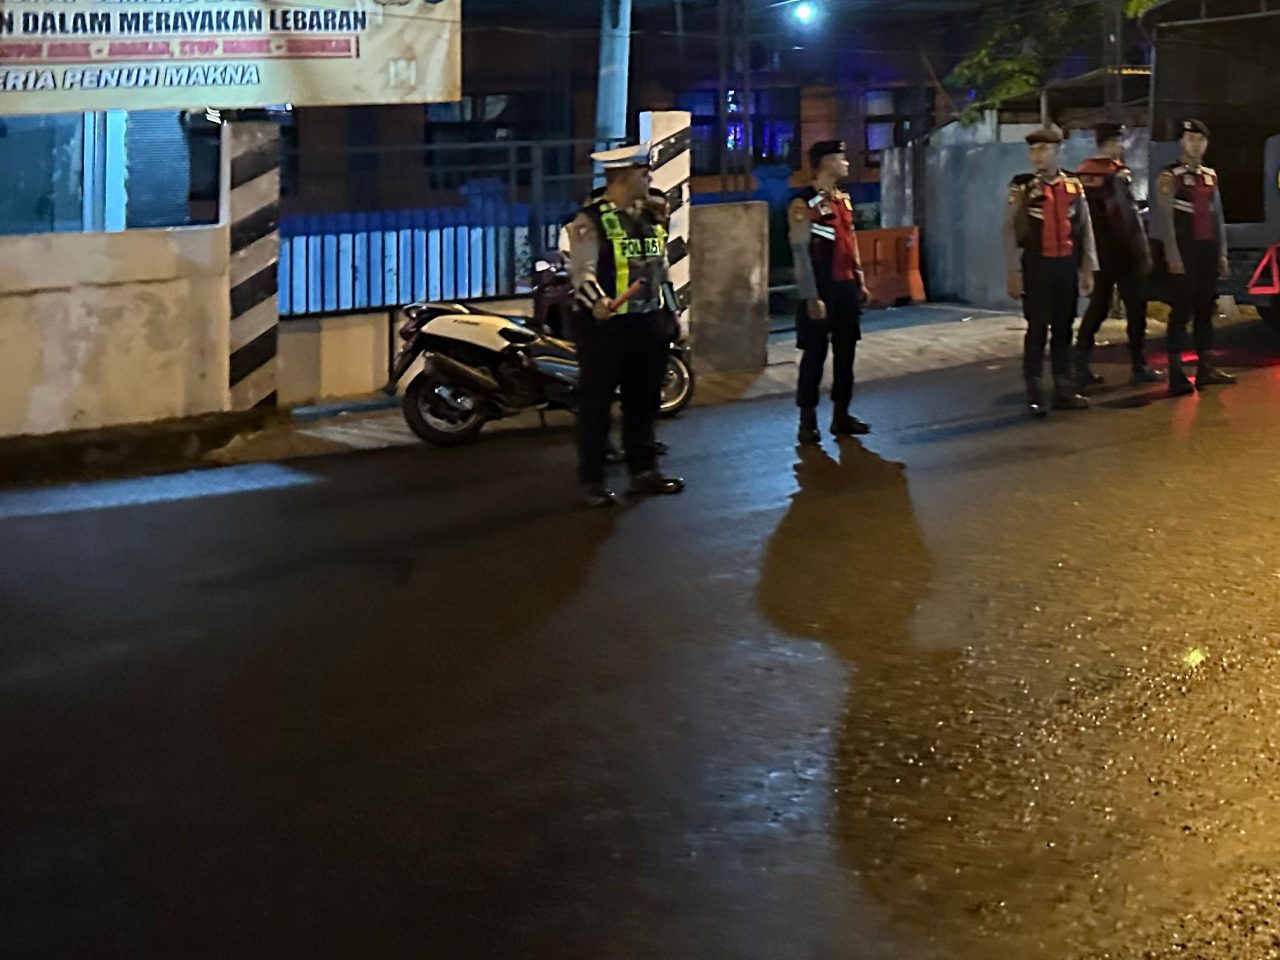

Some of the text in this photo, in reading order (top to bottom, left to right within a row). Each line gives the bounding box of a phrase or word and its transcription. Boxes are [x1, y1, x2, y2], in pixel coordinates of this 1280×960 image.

[22, 11, 111, 34] DALAM
[119, 9, 262, 34] MERAYAKAN
[269, 8, 367, 31] LEBARAN
[63, 66, 158, 90] PENUH
[164, 64, 260, 86] MAKNA
